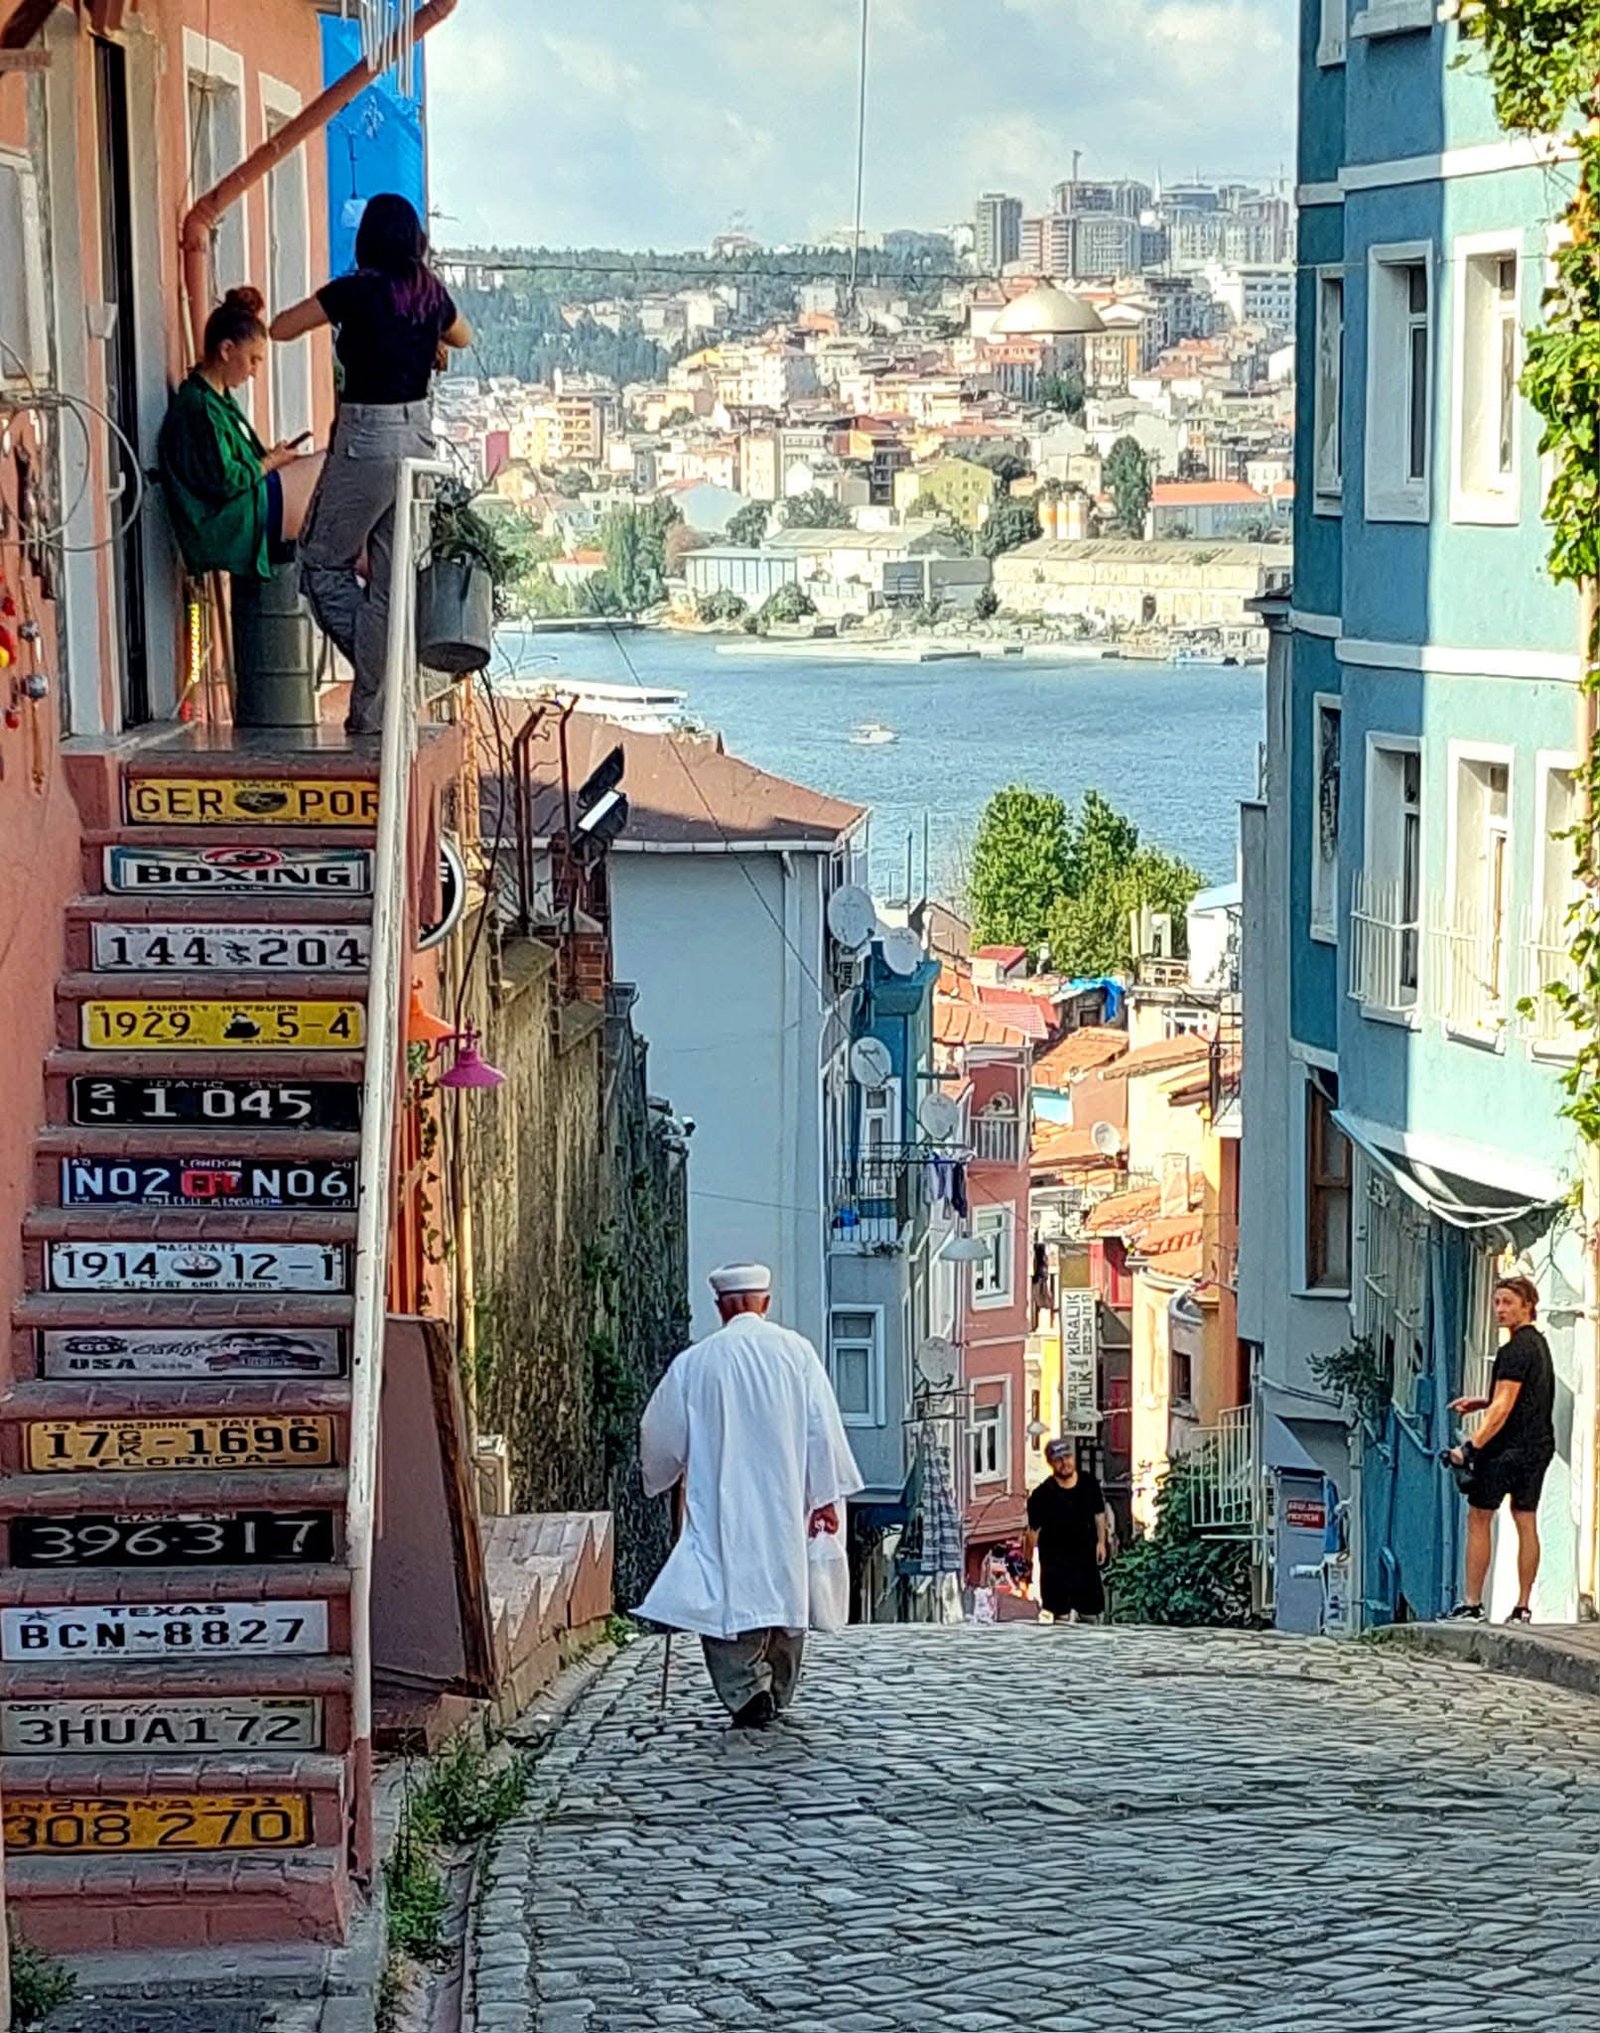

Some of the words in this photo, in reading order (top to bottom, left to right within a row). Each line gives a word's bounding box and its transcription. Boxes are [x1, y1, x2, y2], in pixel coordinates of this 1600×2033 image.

[136, 787, 223, 815] GER
[136, 865, 350, 886] BOXING
[166, 927, 303, 936] LOUISIANA
[110, 937, 213, 966] 144
[258, 938, 370, 968] 204
[100, 1011, 191, 1038] 1929
[180, 1159, 242, 1168] LONDON
[62, 1251, 160, 1279] 1914
[68, 1358, 137, 1370] USA
[96, 1421, 191, 1430] SUNSHINE
[98, 1455, 263, 1466] FLORIDA
[102, 1606, 226, 1617] TEXAS
[19, 1715, 301, 1748] 3HUA172
[2, 1814, 131, 1848] 308
[157, 1810, 292, 1847] 270
